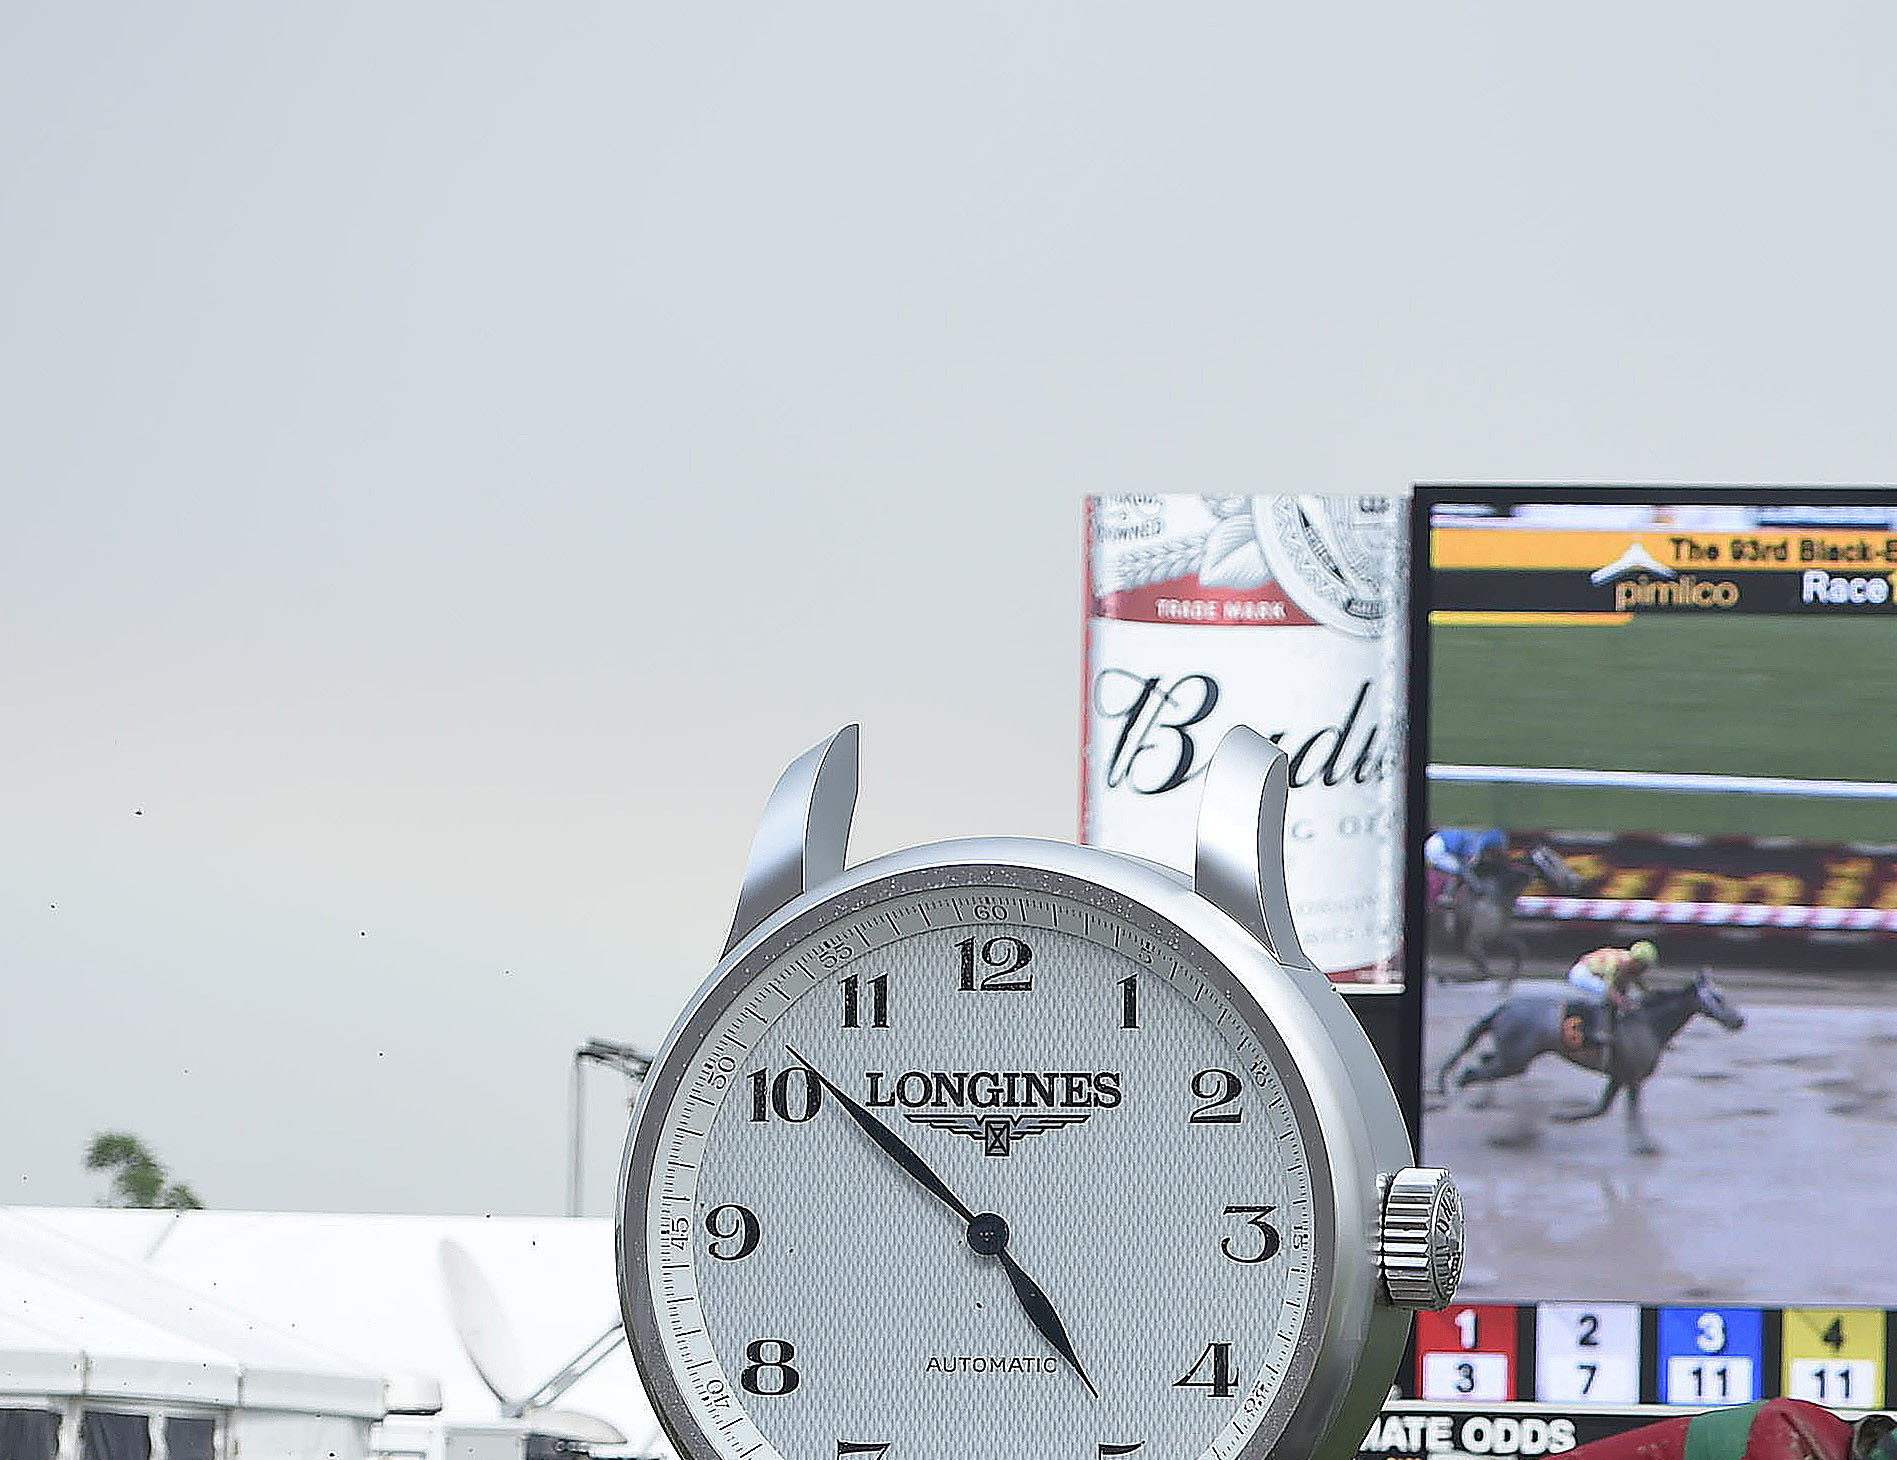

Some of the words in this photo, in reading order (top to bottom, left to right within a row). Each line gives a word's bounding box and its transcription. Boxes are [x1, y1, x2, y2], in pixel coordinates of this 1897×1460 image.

[1671, 538, 1719, 561] The
[1614, 575, 1739, 612] pimlico
[973, 904, 1009, 921] 60
[817, 945, 854, 969] 55
[955, 936, 1034, 992] 12
[840, 972, 890, 1028] 11
[1116, 973, 1140, 1030] 1
[707, 1055, 737, 1091] 50
[746, 1066, 824, 1123] 10
[865, 1071, 1122, 1108] LONGINES
[1189, 1068, 1244, 1124] 2
[704, 1203, 761, 1262] 9
[1220, 1204, 1281, 1265] 3
[1454, 1308, 1478, 1349] 1
[1578, 1314, 1600, 1347] 2
[1696, 1311, 1728, 1354] 3
[1822, 1318, 1845, 1352] 4
[740, 1338, 800, 1396] 8
[925, 1355, 1058, 1375] AUTOMATIC
[1171, 1341, 1240, 1398] 4
[1455, 1362, 1475, 1394] 3
[1577, 1364, 1597, 1395] 7
[1692, 1366, 1728, 1397] 11
[1813, 1368, 1851, 1399] 11
[1461, 1417, 1577, 1455] ODDS
